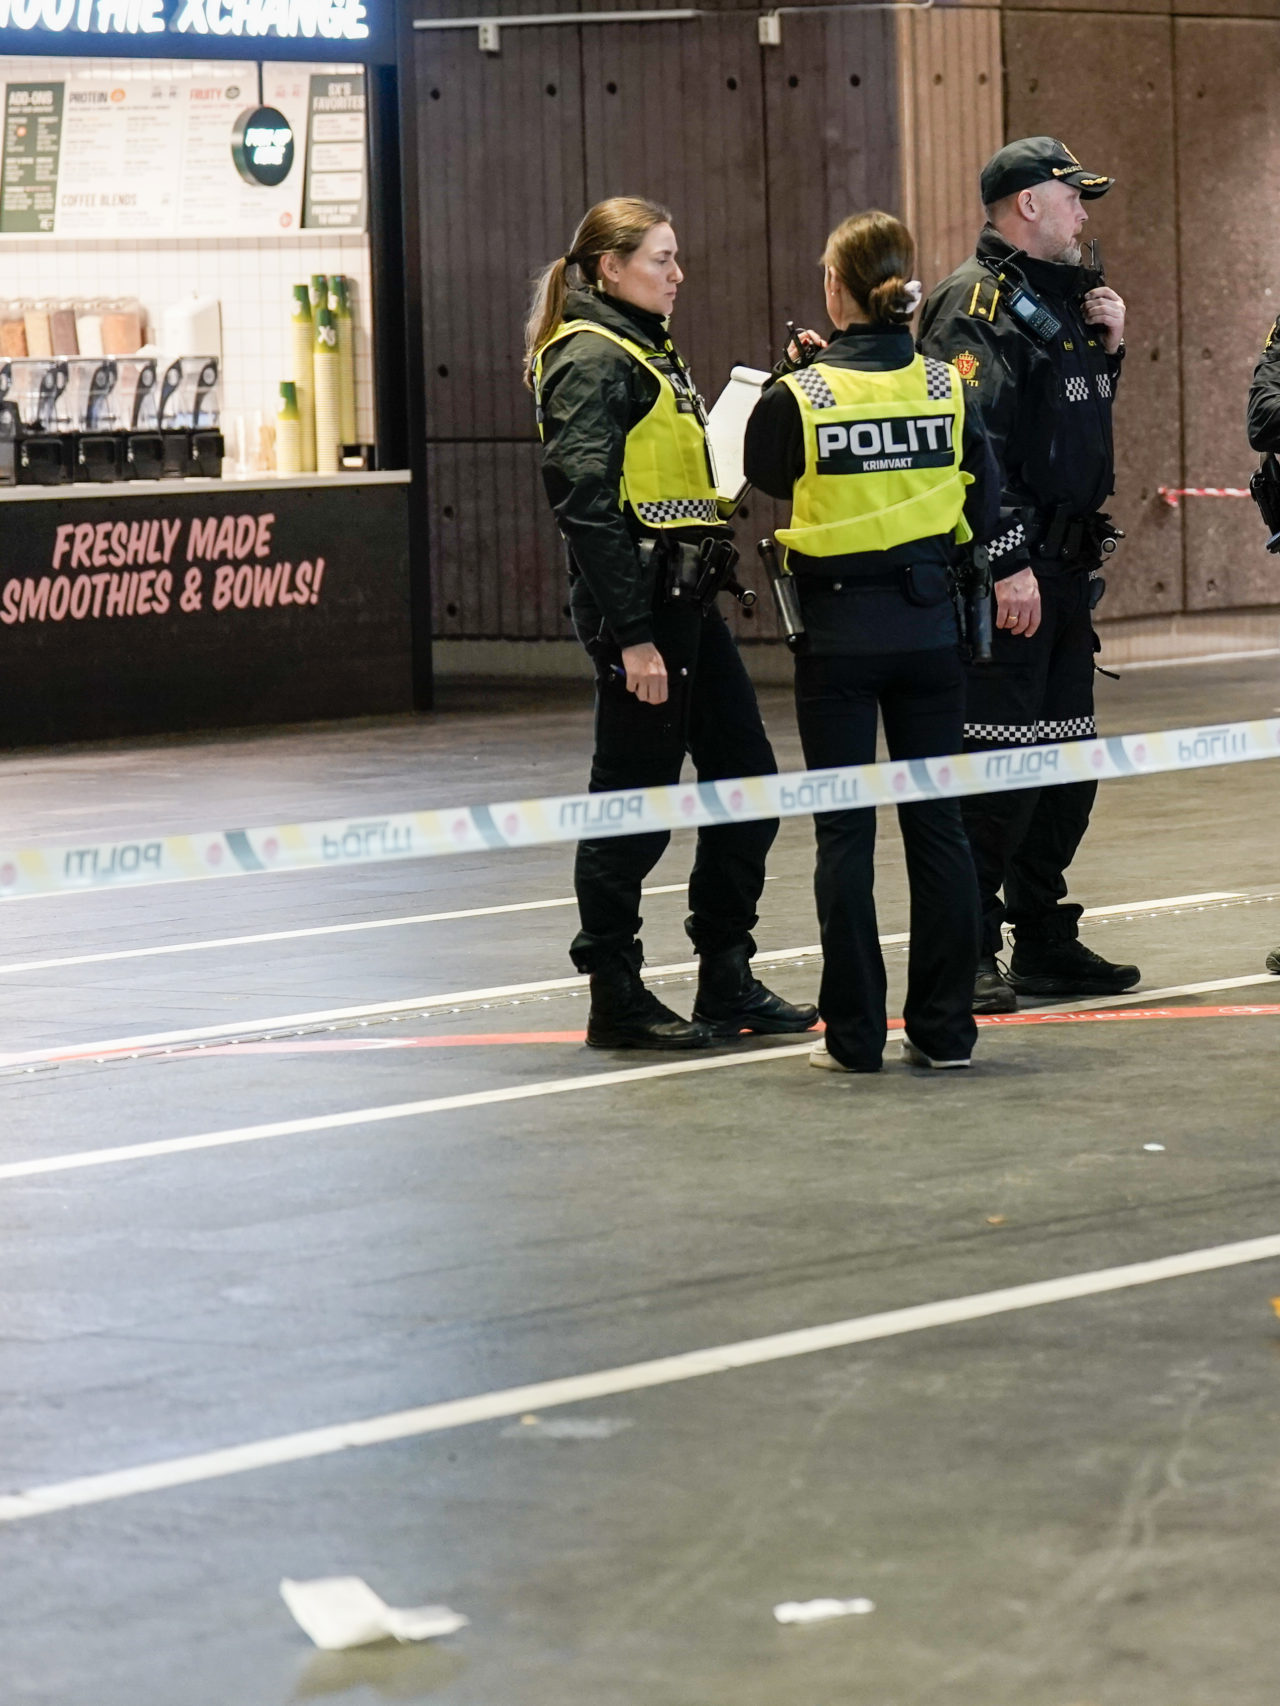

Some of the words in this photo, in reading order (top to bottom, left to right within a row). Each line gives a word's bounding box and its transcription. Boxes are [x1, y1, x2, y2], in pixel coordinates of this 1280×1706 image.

[69, 90, 108, 103] PROTEIN
[190, 88, 222, 100] FRUITY
[62, 194, 95, 207] COFFEE
[100, 193, 136, 206] BLENDS
[818, 417, 953, 458] POLITI
[862, 457, 913, 471] KRIMVAKT
[52, 518, 181, 570] FRESHLY
[186, 513, 275, 562] MADE
[0, 567, 173, 624] SMOOTHIES
[179, 567, 203, 612] &
[212, 557, 325, 611] BOWLS!
